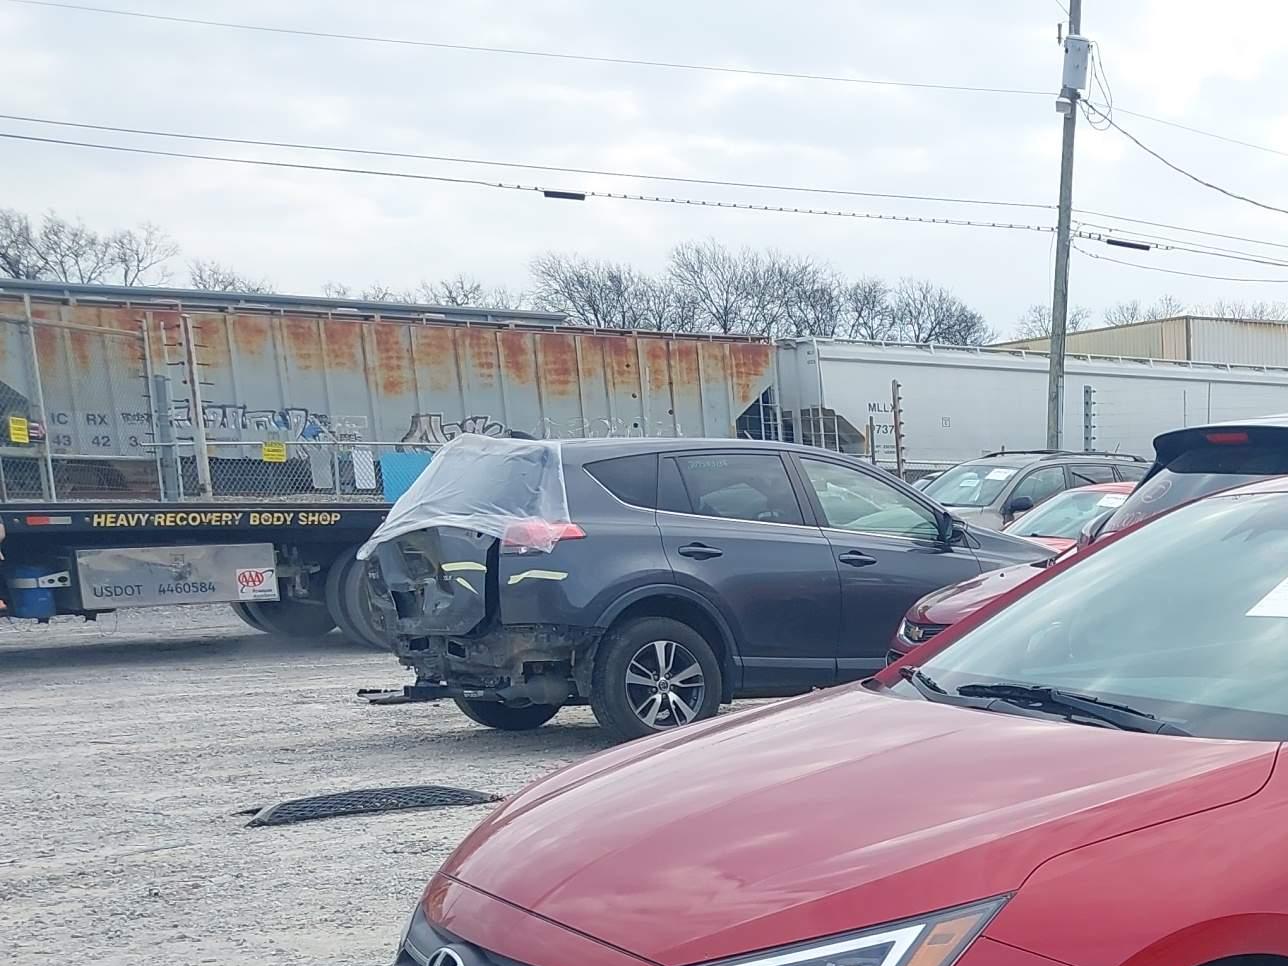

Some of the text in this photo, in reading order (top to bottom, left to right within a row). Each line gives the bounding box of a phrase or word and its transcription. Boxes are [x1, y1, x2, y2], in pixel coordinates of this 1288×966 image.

[93, 512, 341, 527] HEAVY RECOVERY BODY SHOP
[239, 571, 263, 587] AAA
[93, 583, 216, 598] USDOT 4460584
